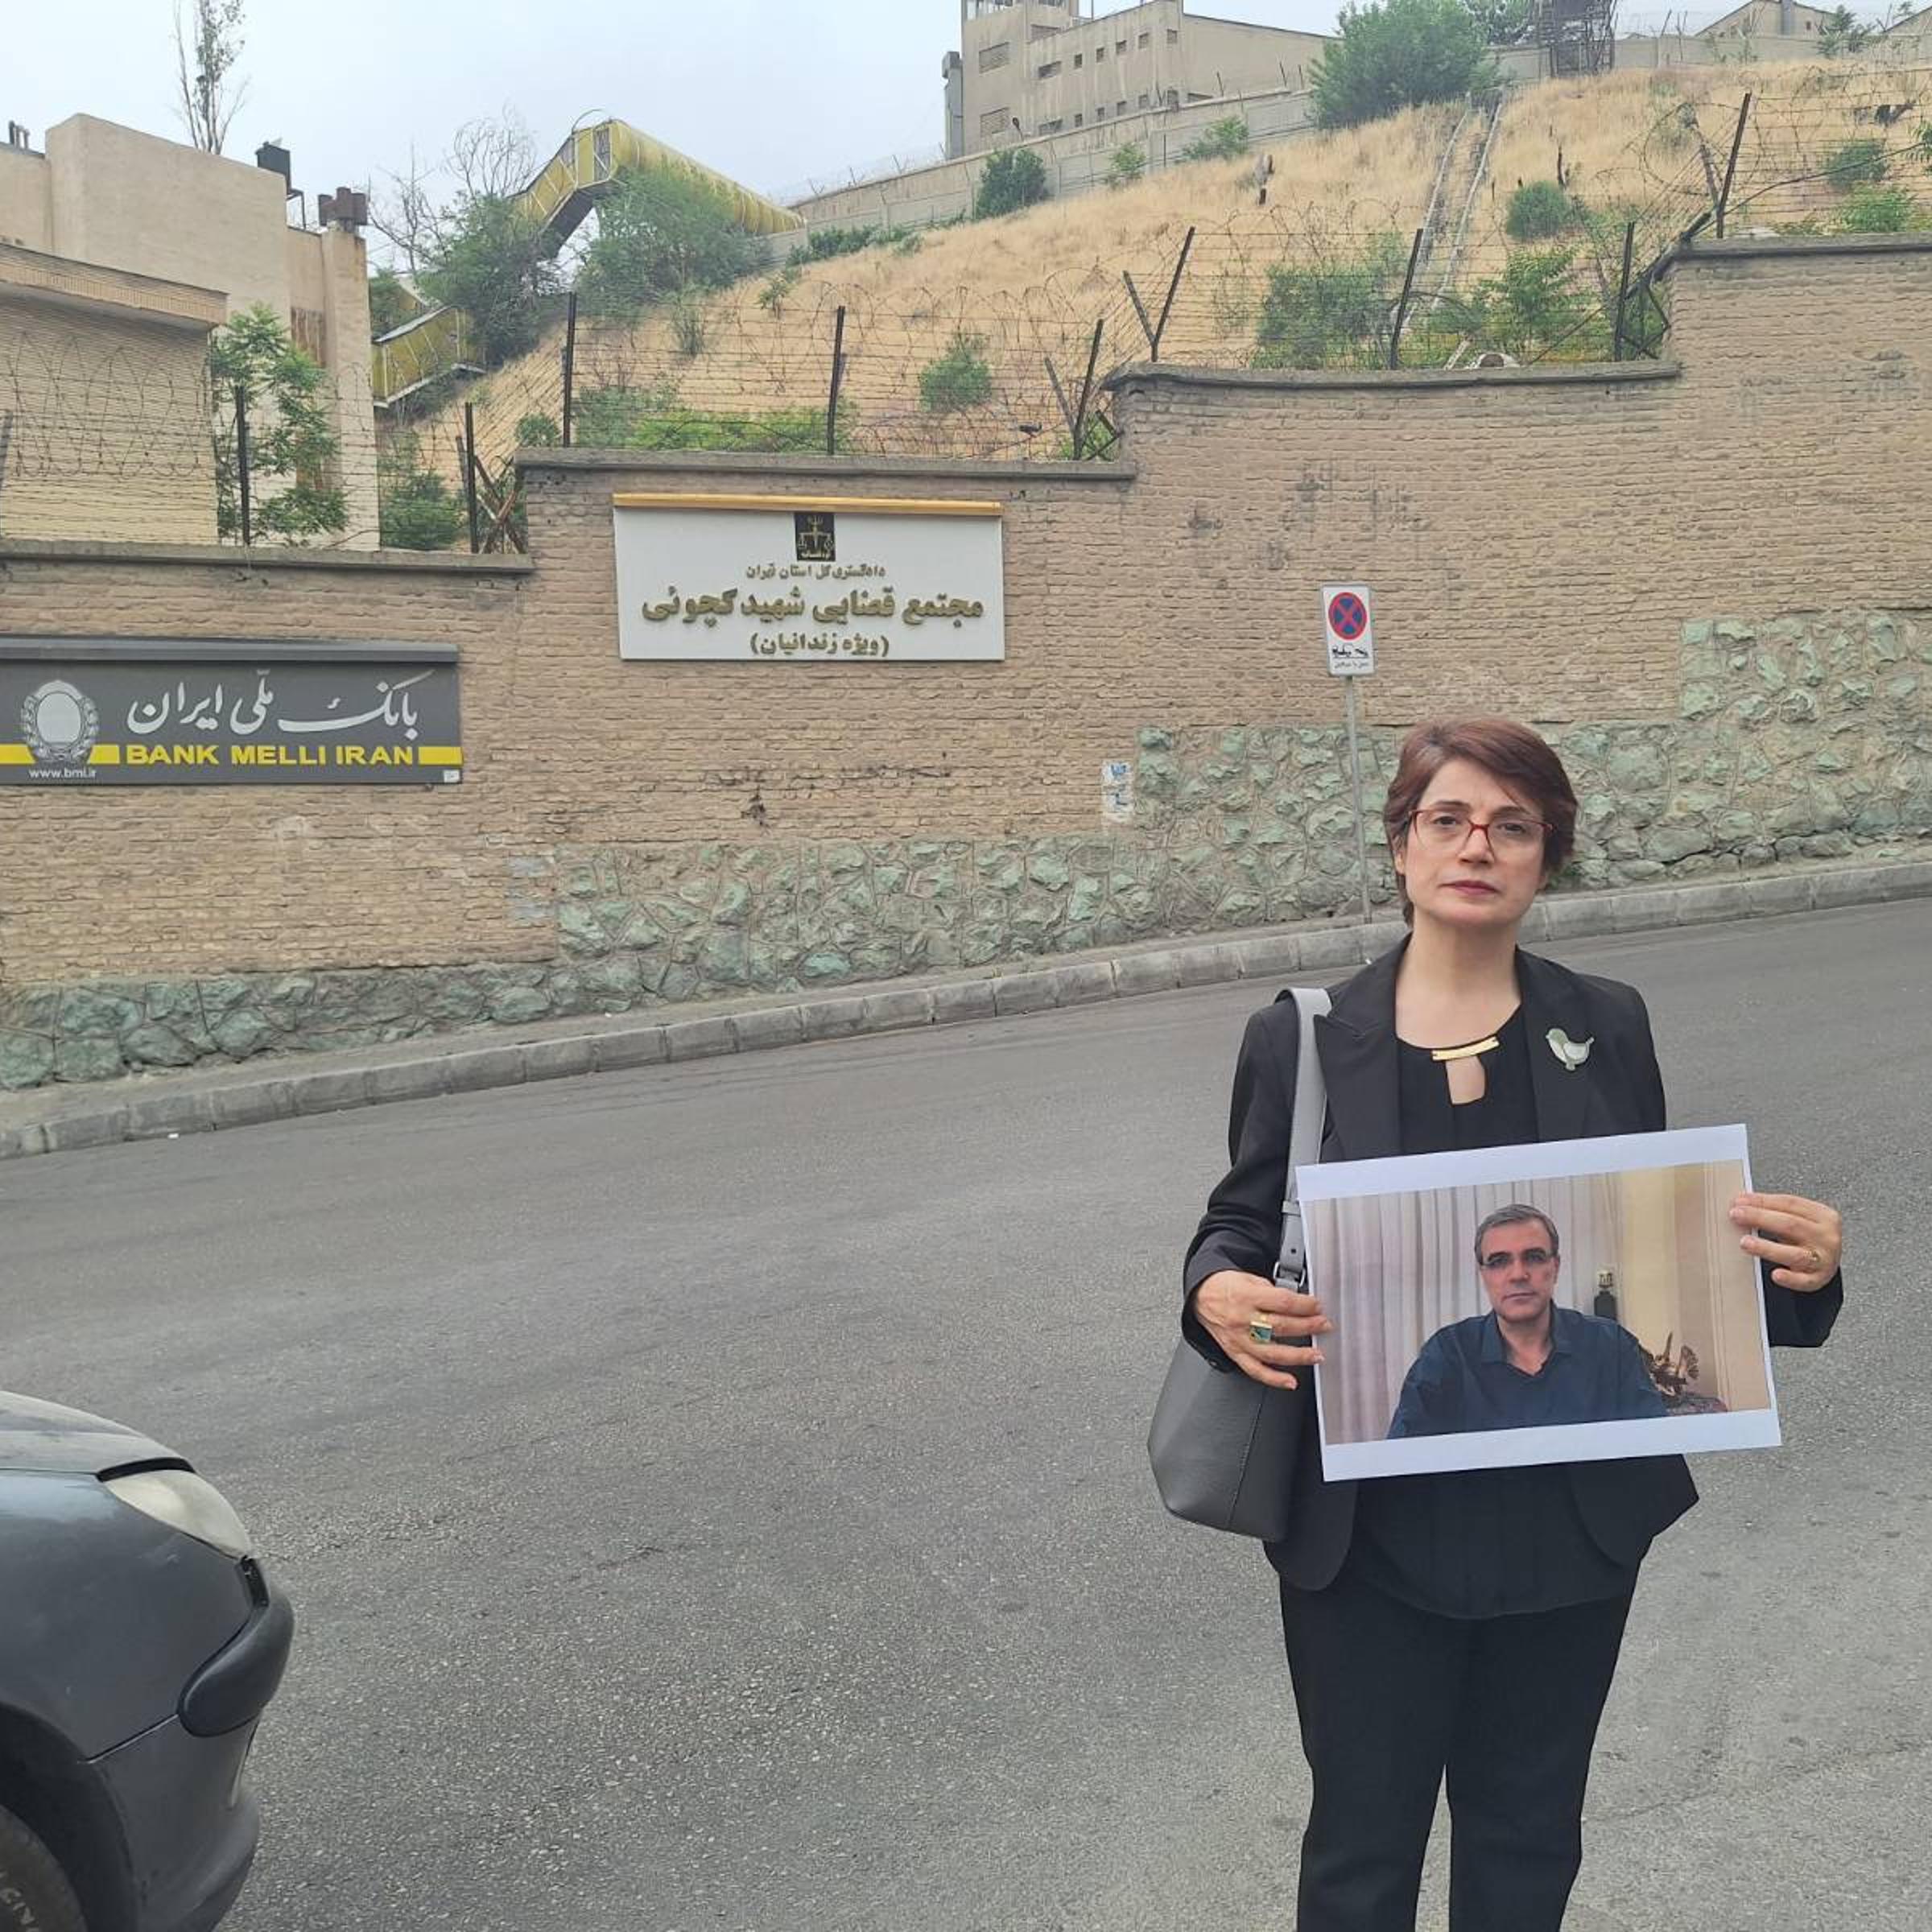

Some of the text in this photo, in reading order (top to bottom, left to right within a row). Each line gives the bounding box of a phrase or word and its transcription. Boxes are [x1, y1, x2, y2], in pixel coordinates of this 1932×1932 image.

[746, 563, 775, 580] تهران
[779, 564, 812, 580] استان
[815, 564, 832, 580] کل
[740, 585, 805, 623] شهید
[902, 592, 984, 629] مجتمع
[126, 682, 223, 735] ایران
[278, 669, 436, 741] بانک
[126, 745, 414, 765] BANK MELLI IRAN
